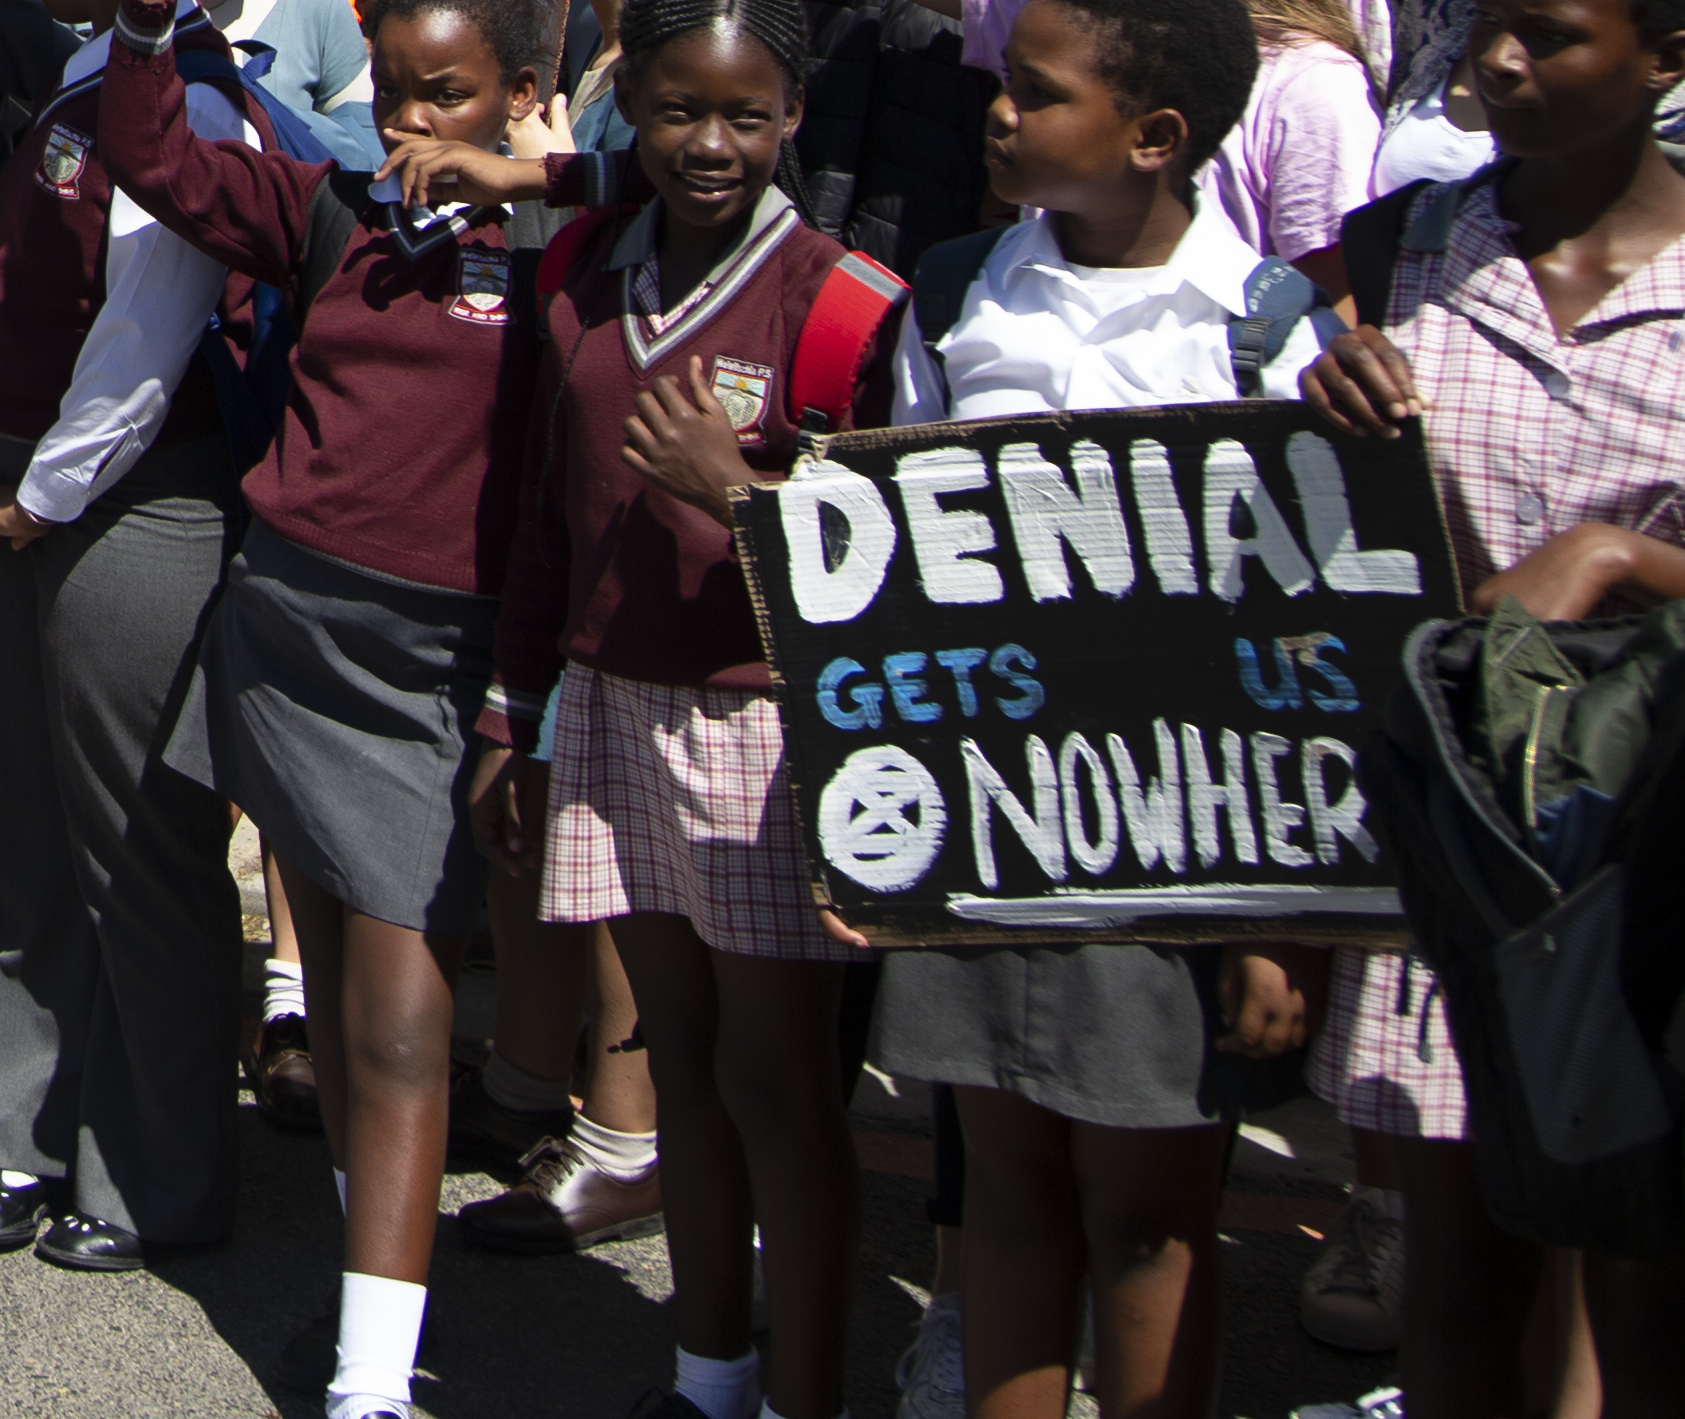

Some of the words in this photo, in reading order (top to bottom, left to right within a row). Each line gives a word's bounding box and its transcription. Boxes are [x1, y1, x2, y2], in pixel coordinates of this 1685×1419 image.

[777, 429, 1423, 624] DENIAL
[816, 643, 1045, 731] GETS
[1233, 632, 1361, 714] US
